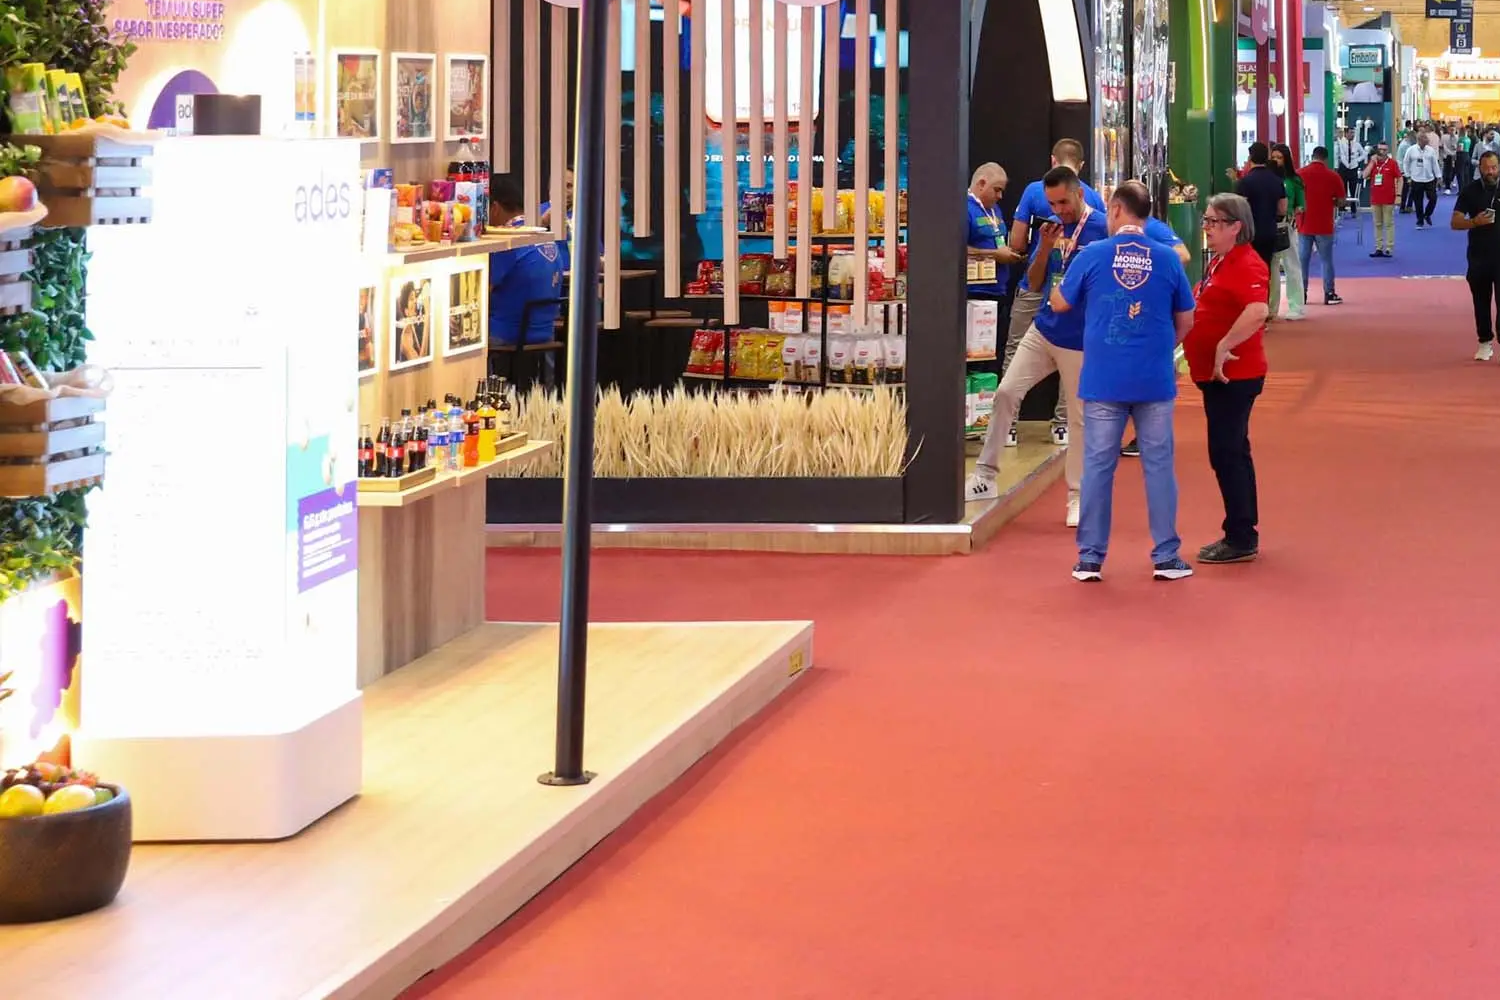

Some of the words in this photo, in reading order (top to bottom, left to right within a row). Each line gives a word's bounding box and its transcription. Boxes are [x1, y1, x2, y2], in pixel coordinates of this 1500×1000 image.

[146, 0, 170, 17] TEM
[173, 1, 189, 17] UM
[191, 1, 224, 19] SUPER
[114, 19, 152, 37] SABOR
[156, 20, 225, 39] INESPERADO?
[294, 167, 350, 222] ades
[1115, 255, 1152, 265] MOINHO
